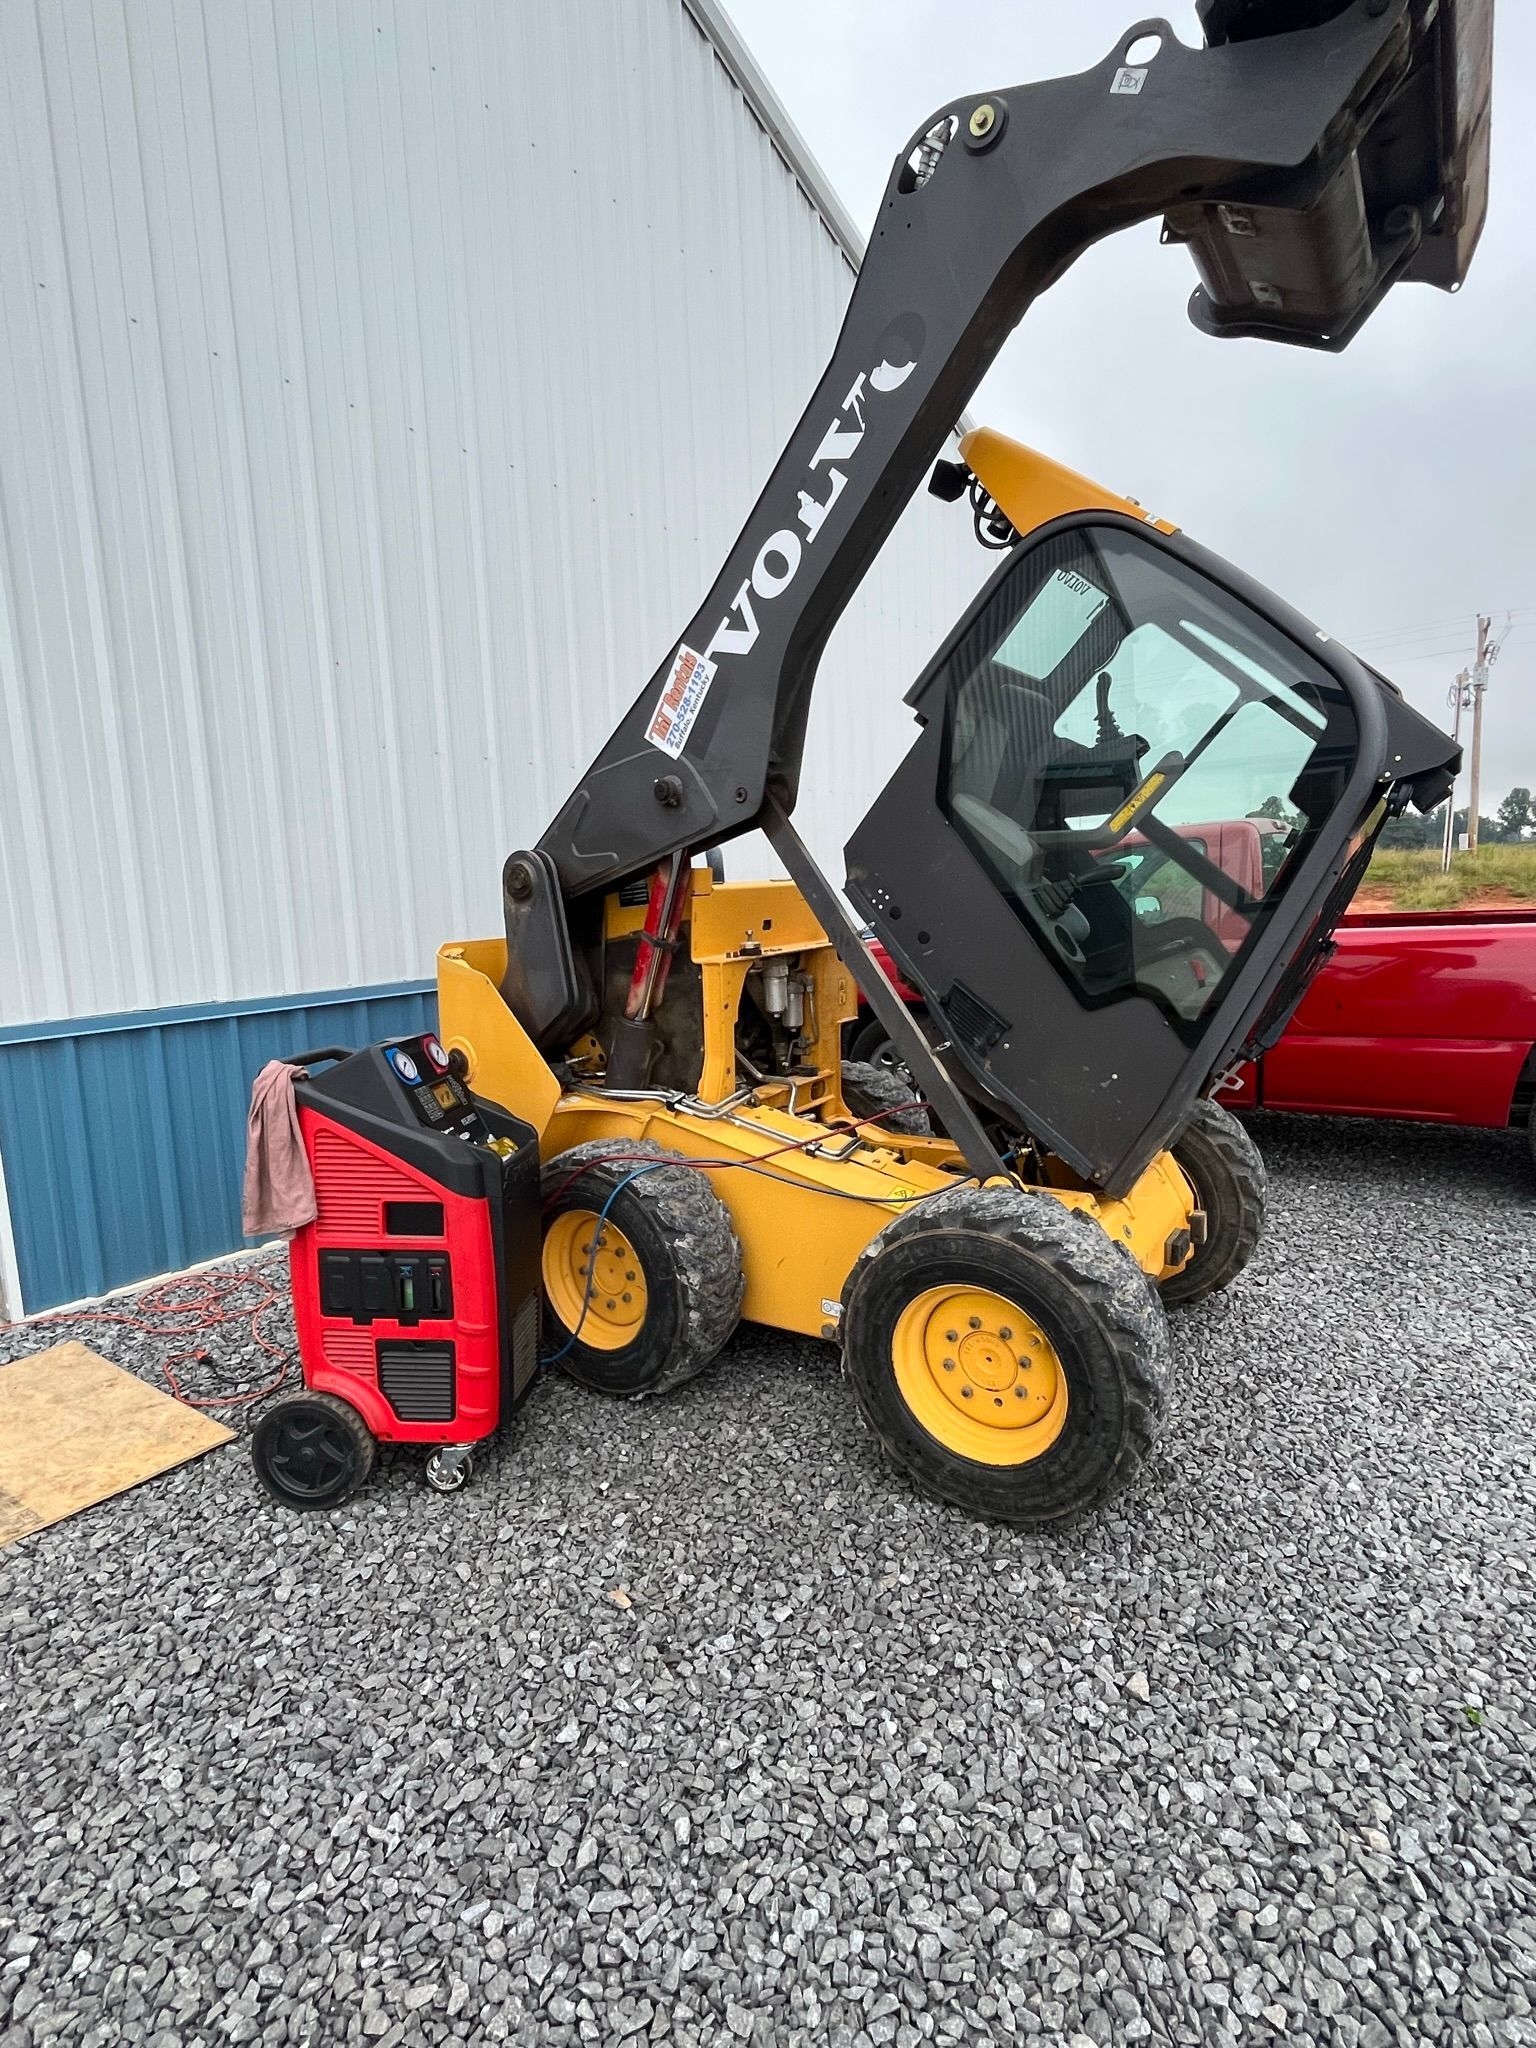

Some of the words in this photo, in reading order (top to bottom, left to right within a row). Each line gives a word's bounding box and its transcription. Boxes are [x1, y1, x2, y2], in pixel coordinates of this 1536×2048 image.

[663, 651, 698, 713] Rentals
[666, 662, 706, 748] 270-528-1193
[689, 674, 710, 715] Kentucky
